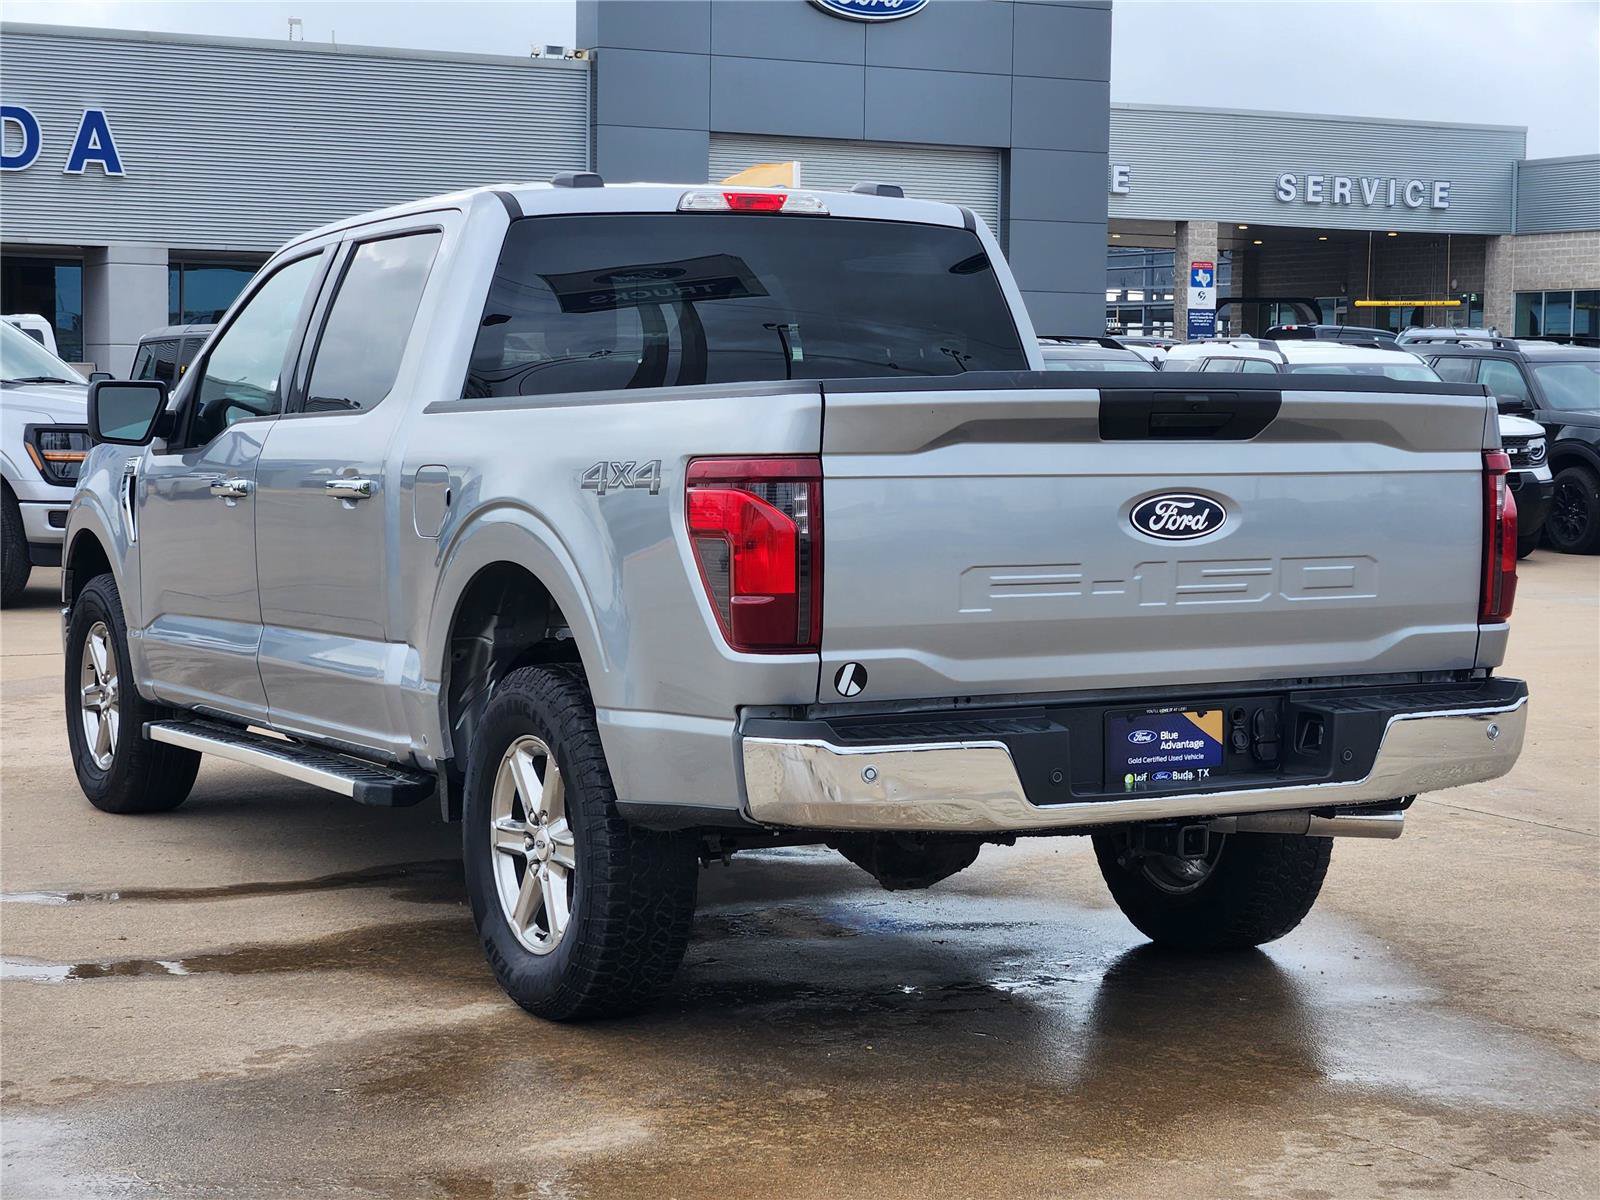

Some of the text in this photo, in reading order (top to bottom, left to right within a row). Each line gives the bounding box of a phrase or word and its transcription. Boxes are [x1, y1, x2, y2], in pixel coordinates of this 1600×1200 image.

[1276, 173, 1451, 210] SERVICE
[1148, 500, 1210, 532] Ford
[958, 554, 1378, 613] F-150
[1160, 730, 1179, 740] Blue
[1160, 739, 1205, 750] Advantage
[1127, 757, 1142, 765] Gold
[1142, 755, 1168, 763] Certified
[1197, 768, 1210, 779] TX
